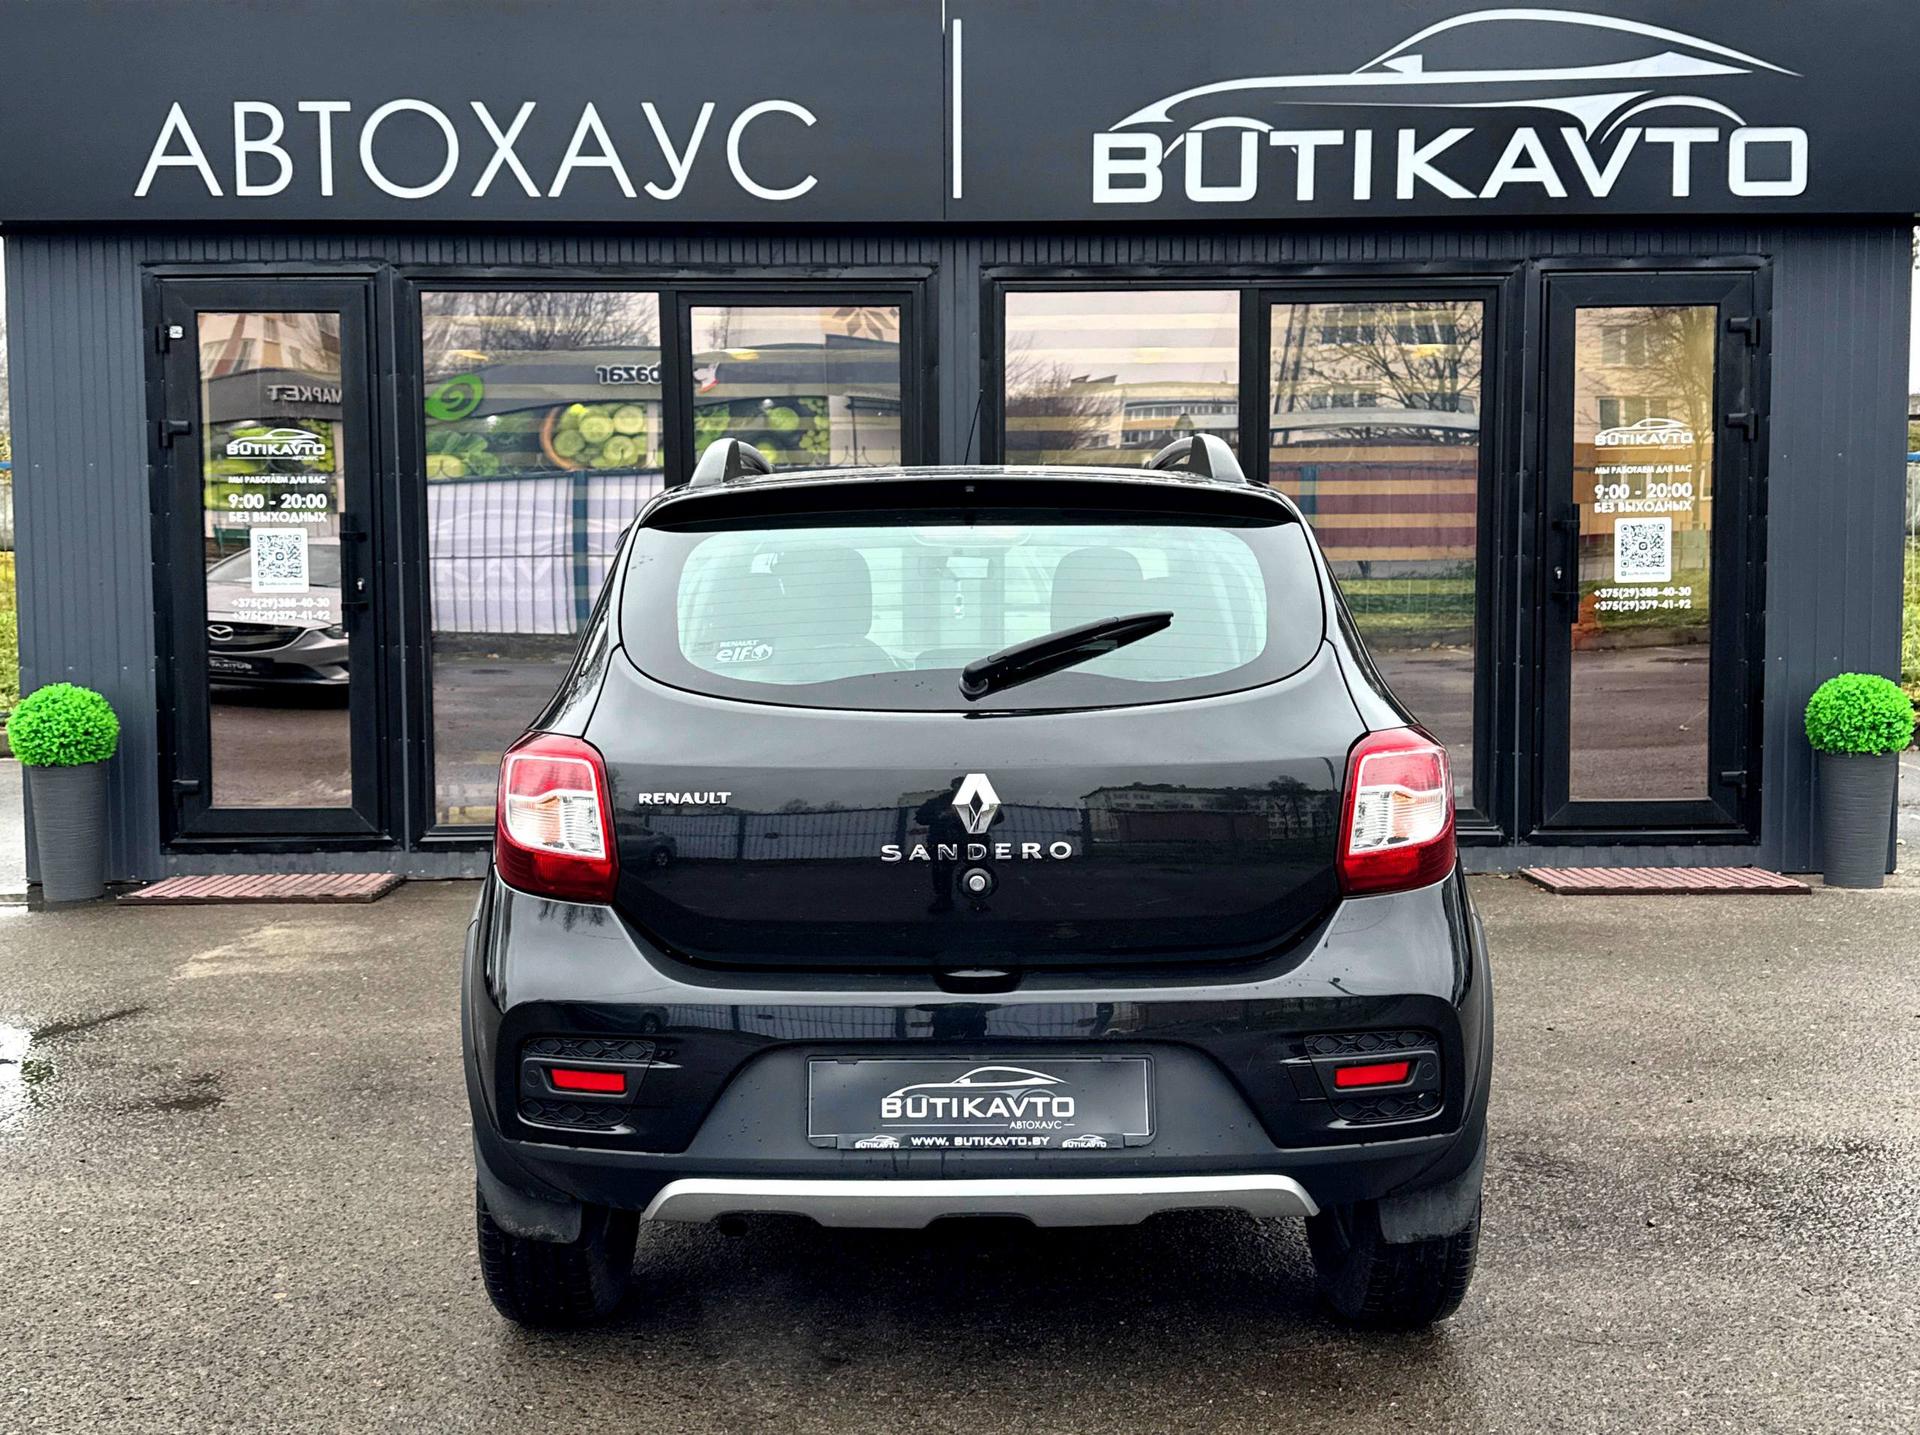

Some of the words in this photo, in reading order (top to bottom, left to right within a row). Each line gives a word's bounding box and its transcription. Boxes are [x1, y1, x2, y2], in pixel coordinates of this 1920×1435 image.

[133, 97, 820, 201] АВТОХАУС
[1092, 126, 1809, 204] BUTIKAVTO
[1594, 431, 1693, 446] BUTIKAVTO
[226, 443, 326, 456] BUTIKAVTO
[1594, 466, 1610, 475] МЫ
[1611, 465, 1654, 474] РАБОТАЕМ
[1655, 465, 1673, 474] ДЛЯ
[1675, 464, 1693, 473] ВАС
[1594, 483, 1630, 500] 9:00
[1647, 482, 1693, 499] 20:00
[227, 493, 265, 509] 9:00
[280, 493, 328, 509] 20:00
[1594, 502, 1615, 513] БЕЗ
[1617, 501, 1692, 513] ВЫХОДНЫХ
[228, 511, 250, 522] БЕЗ
[252, 511, 328, 523] ВЫХОДНЫХ
[1593, 586, 1692, 599] +375(29)388-40-30
[1593, 599, 1692, 612] +375(29)379-41-92
[716, 646, 752, 661] elf
[638, 791, 732, 806] RENAULT
[880, 842, 1074, 862] SANDERO
[881, 1097, 1075, 1118] BUTIKAVTO
[1009, 1120, 1062, 1130] АВТОХАУС
